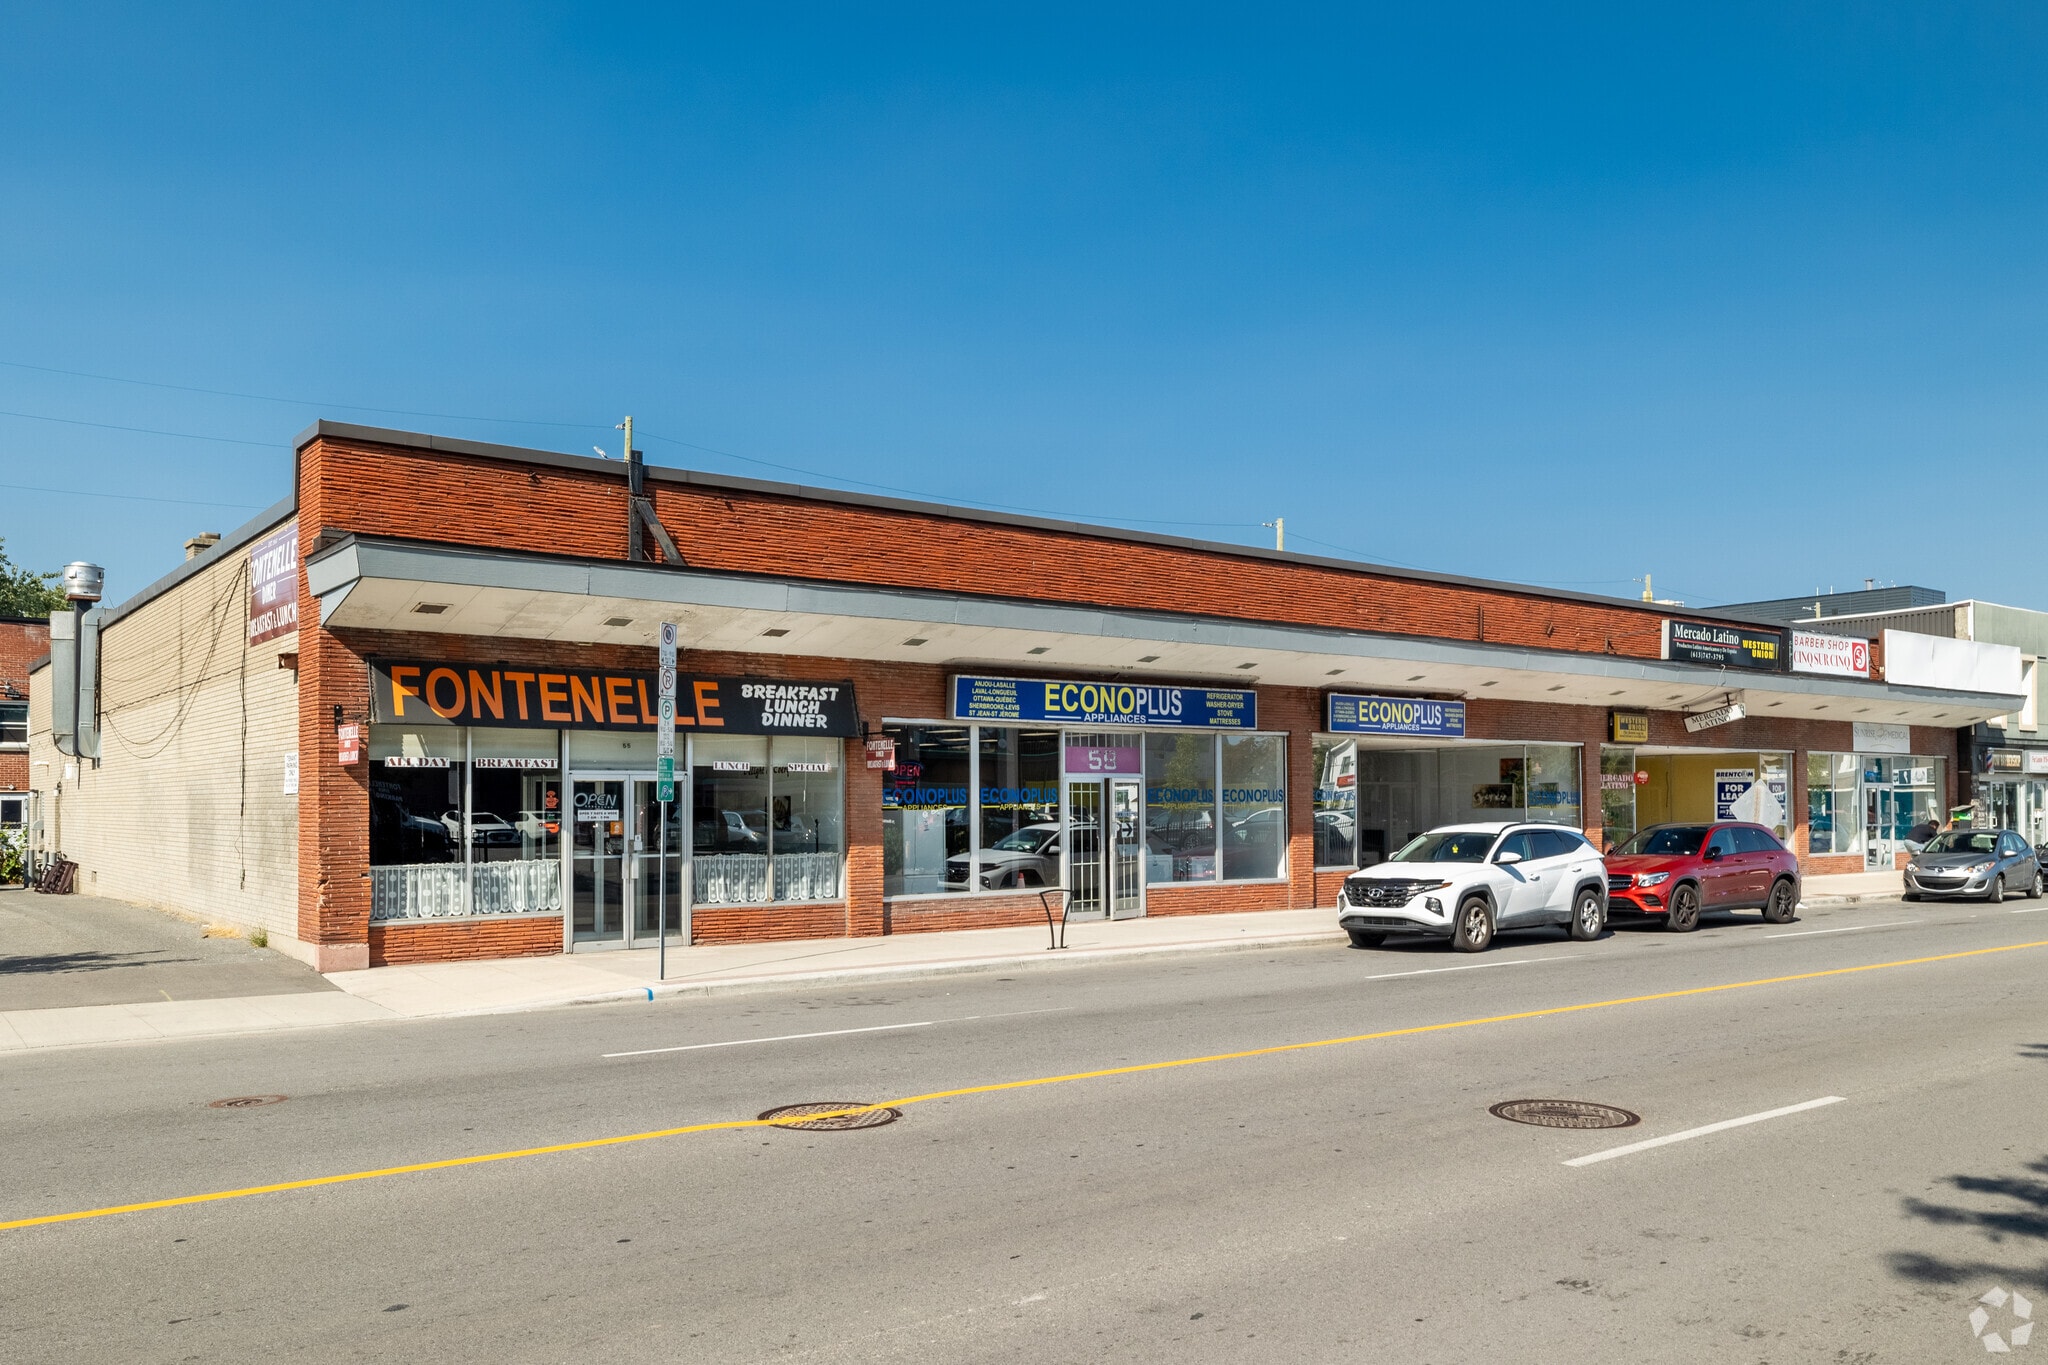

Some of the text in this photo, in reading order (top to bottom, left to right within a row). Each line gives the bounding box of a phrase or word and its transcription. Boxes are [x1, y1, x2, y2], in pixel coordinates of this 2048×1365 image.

[276, 602, 297, 627] LUNCH
[1674, 624, 1739, 645] Mercado Latino
[1742, 639, 1774, 650] WESTERN
[1794, 636, 1849, 651] BARBER SHOP
[1752, 650, 1773, 659] UNION
[741, 684, 839, 701] BREAKFAST
[1206, 692, 1244, 700] REFRIGERATOR
[1045, 683, 1182, 716] ECONOPLUS
[764, 699, 820, 714] LUNCH
[1084, 713, 1146, 724] APPLIANCES
[1359, 701, 1442, 726] ECONOPLUS
[1691, 706, 1733, 724] MERCADO
[761, 713, 828, 728] DINNER
[1210, 718, 1241, 726] MATTRESSES
[1382, 723, 1420, 731] APPLIANCES
[1699, 715, 1731, 729] LATINO
[866, 740, 894, 751] FONTENELLE
[419, 758, 449, 767] DAY
[477, 758, 558, 768] BREAKFAST
[714, 762, 749, 770] LUNCH
[788, 764, 826, 772] SPECIAL
[894, 764, 920, 776] OPEN
[1725, 784, 1744, 792] FOR
[574, 792, 616, 807] OPEN
[882, 788, 966, 804] ECONOPLUS
[981, 788, 1058, 803] ECONOPLUS
[1148, 788, 1213, 803] ECONOPLUS
[1223, 789, 1284, 802] ECONOPLUS
